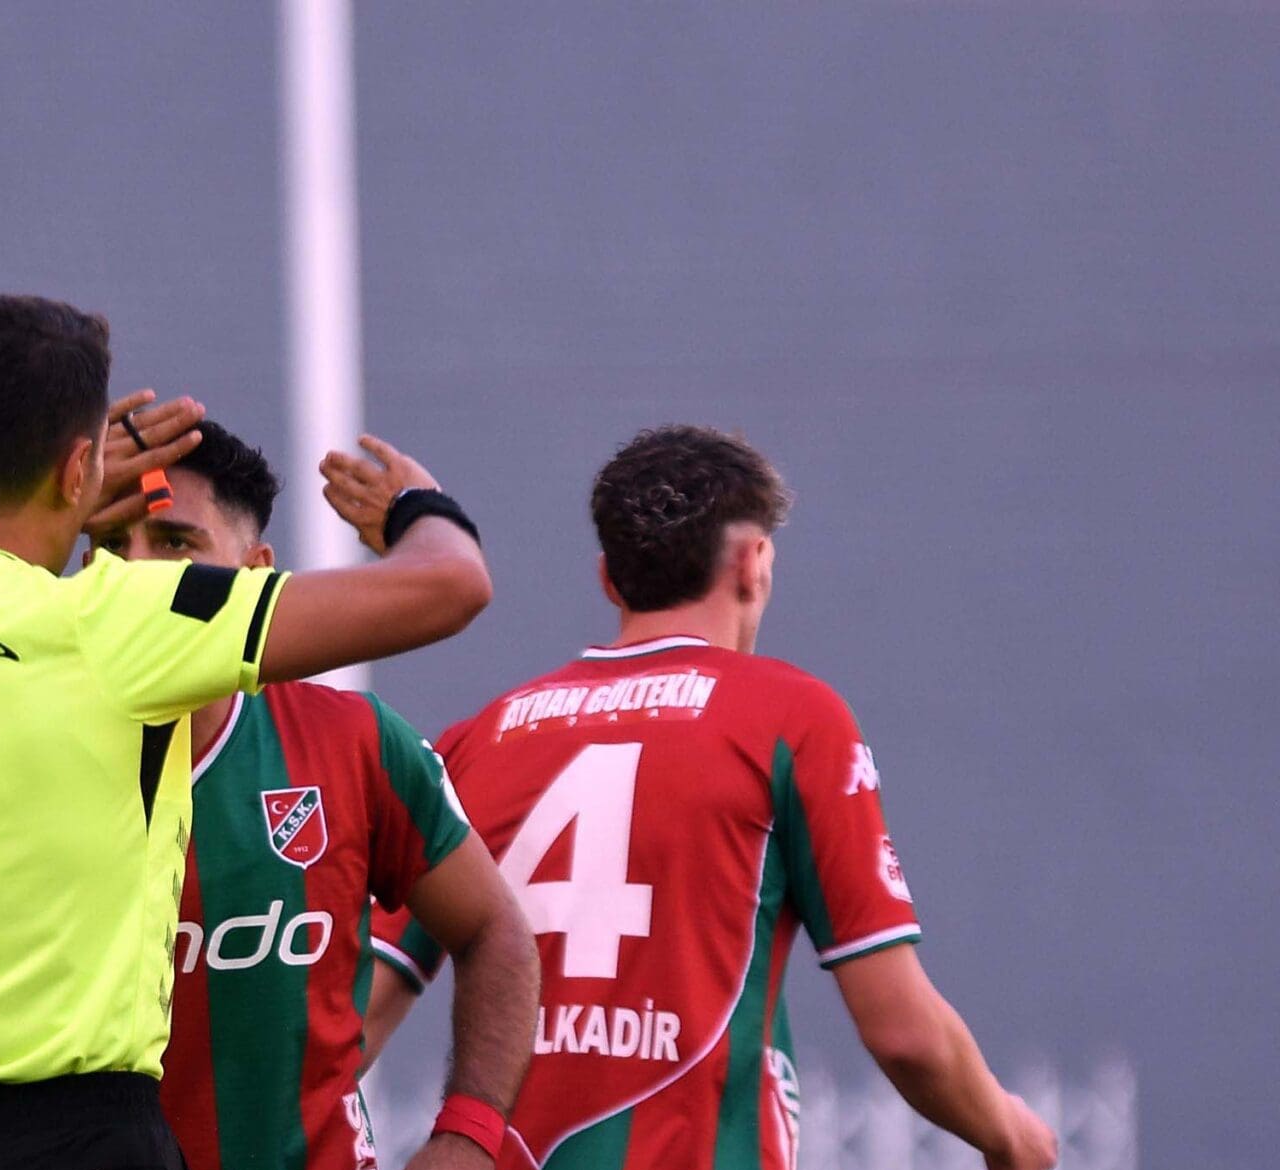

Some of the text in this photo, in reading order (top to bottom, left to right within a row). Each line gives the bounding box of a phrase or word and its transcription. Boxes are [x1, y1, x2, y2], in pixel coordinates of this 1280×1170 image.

[278, 802, 313, 841] K.S.K.
[499, 742, 653, 979] 4
[175, 900, 334, 974] ndo
[534, 997, 681, 1062] LKADİR
